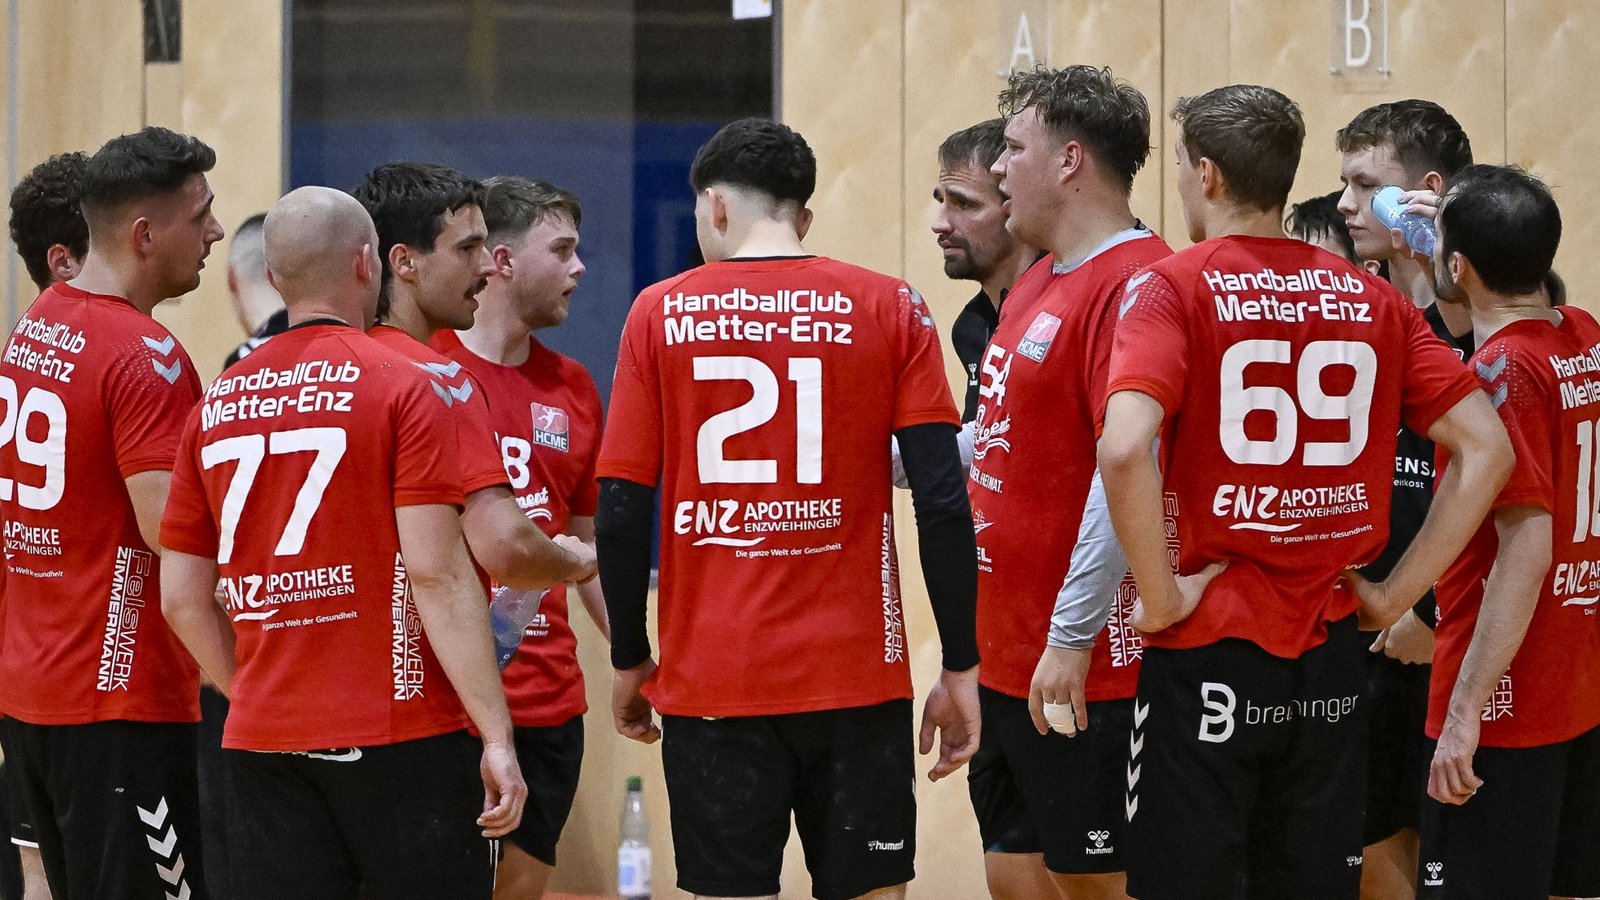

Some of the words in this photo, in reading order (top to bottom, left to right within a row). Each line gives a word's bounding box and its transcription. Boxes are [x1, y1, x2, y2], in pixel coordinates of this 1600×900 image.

[1009, 13, 1036, 70] A
[1344, 0, 1373, 67] B
[1202, 268, 1364, 294] HandballClub
[663, 288, 853, 315] HandballClub
[1214, 294, 1373, 323] Metter-Enz
[664, 315, 853, 346] Metter-Enz
[204, 360, 361, 401] HandballClub
[979, 343, 1014, 407] 54
[201, 386, 354, 432] Metter-Enz
[692, 356, 823, 485] 21
[1219, 339, 1378, 466] 69
[535, 430, 567, 450] HCME
[495, 431, 532, 490] 8
[201, 427, 347, 564] 77
[1212, 484, 1279, 519] ENZ
[1280, 483, 1367, 507] APOTHEKE
[1279, 501, 1369, 519] ENZWEIHINGEN
[674, 498, 741, 534] ENZ
[743, 498, 842, 521] APOTHEKE
[744, 517, 842, 533] ENZWEIHINGEN
[1270, 535, 1282, 543] Die
[1283, 536, 1303, 544] ganze
[1330, 524, 1373, 539] Gesundheit
[735, 550, 748, 558] Die
[749, 551, 770, 559] ganze
[804, 543, 842, 554] Gesundheit
[265, 584, 355, 605] NZWEIHINGEN
[1553, 560, 1590, 596] ENZ
[96, 546, 129, 691] ZIMMERMANN
[285, 618, 301, 627] Welt
[302, 617, 315, 626] der
[315, 611, 358, 623] Gesundheit
[391, 552, 406, 701] ZIMMERMANN
[1085, 846, 1114, 855] hummel
